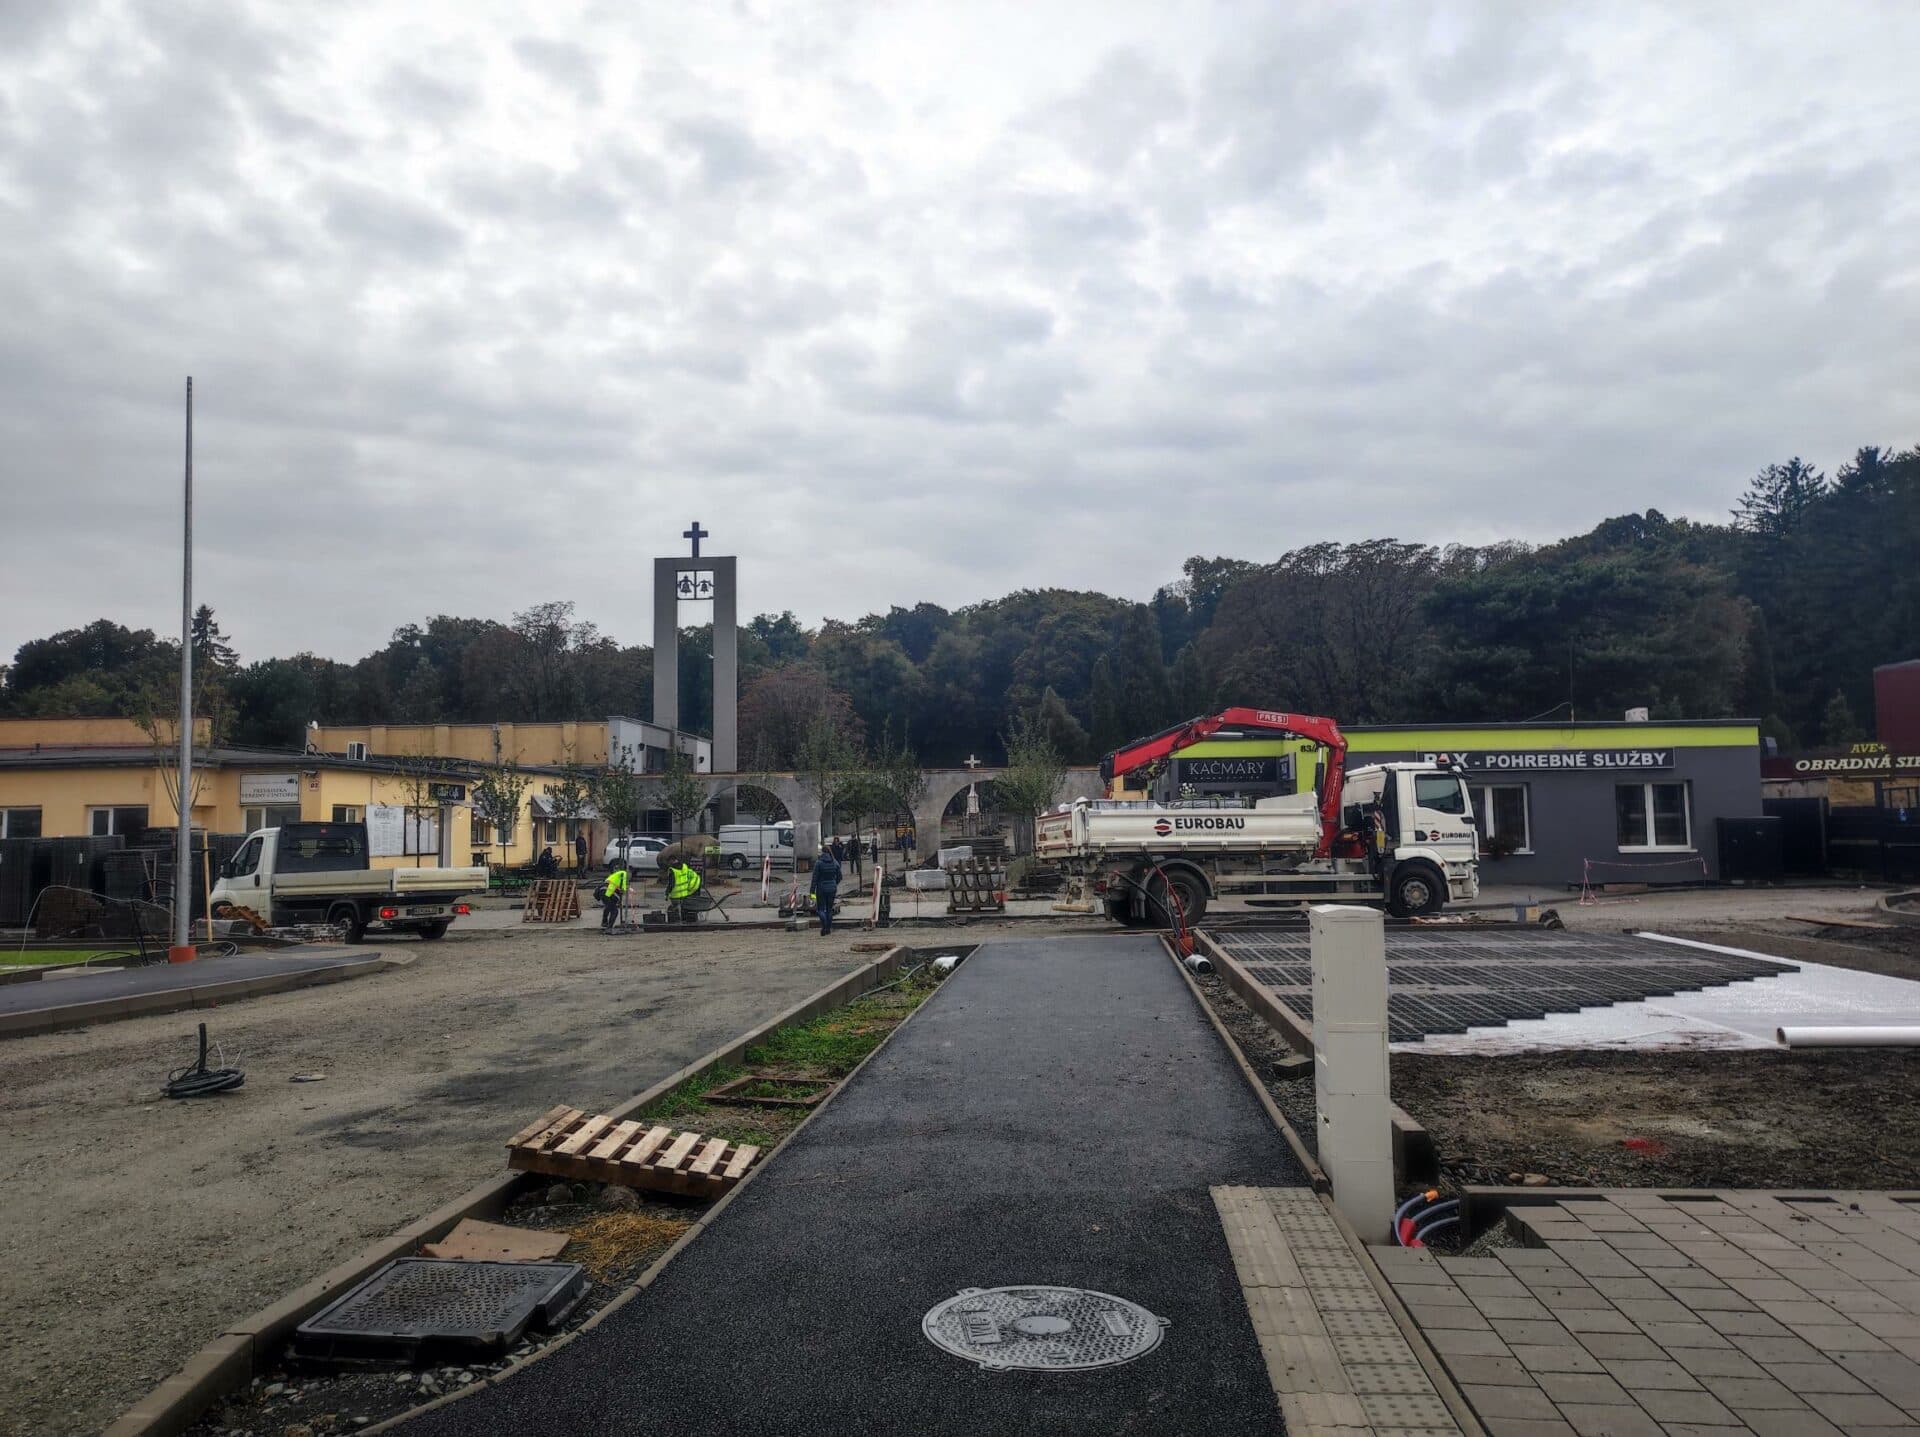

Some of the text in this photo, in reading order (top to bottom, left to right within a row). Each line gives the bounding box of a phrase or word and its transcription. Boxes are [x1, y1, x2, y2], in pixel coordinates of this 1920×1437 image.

[1259, 713, 1286, 723] FASSI
[1850, 743, 1887, 754] AVE+
[1485, 751, 1588, 768] POHREBNÉ
[1593, 750, 1666, 766] SLUŽBY
[1795, 754, 1892, 771] OBRADNÁ
[1189, 760, 1265, 775] KAČMÁRY
[1175, 818, 1245, 829] EUROBAU
